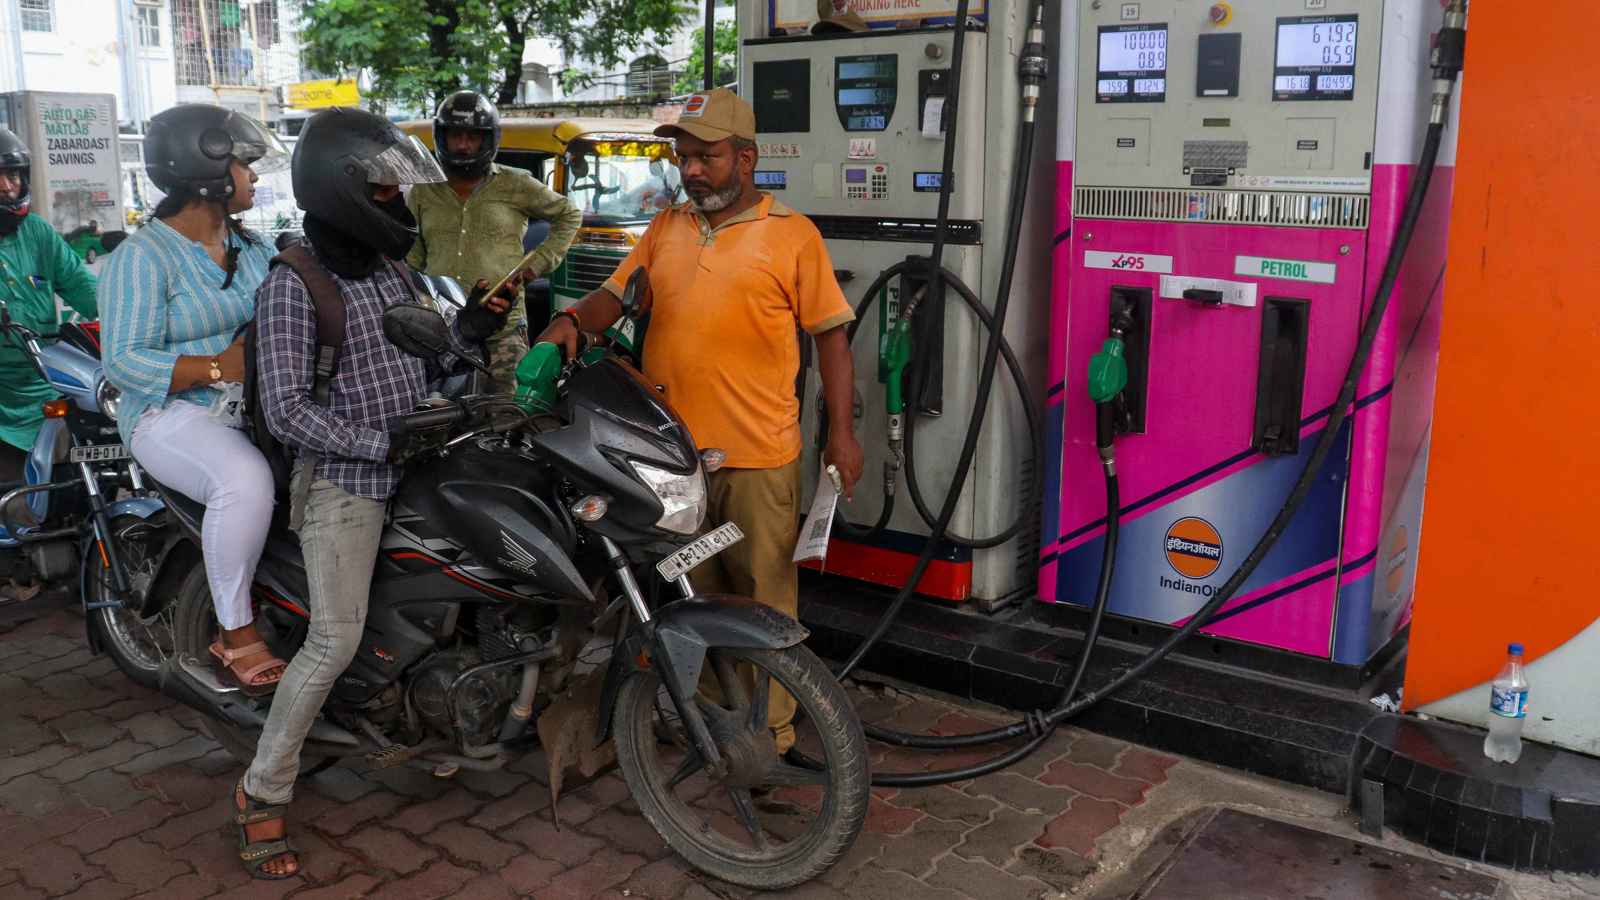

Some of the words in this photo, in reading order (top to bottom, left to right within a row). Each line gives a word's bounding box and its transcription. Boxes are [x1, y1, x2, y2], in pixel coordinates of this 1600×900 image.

[1312, 23, 1355, 44] 61.92
[1322, 46, 1353, 64] 0.59
[44, 108, 72, 120] AUTO
[46, 122, 88, 136] MATLAB
[47, 137, 110, 151] ZABARDAST
[1260, 260, 1309, 279] PETROL
